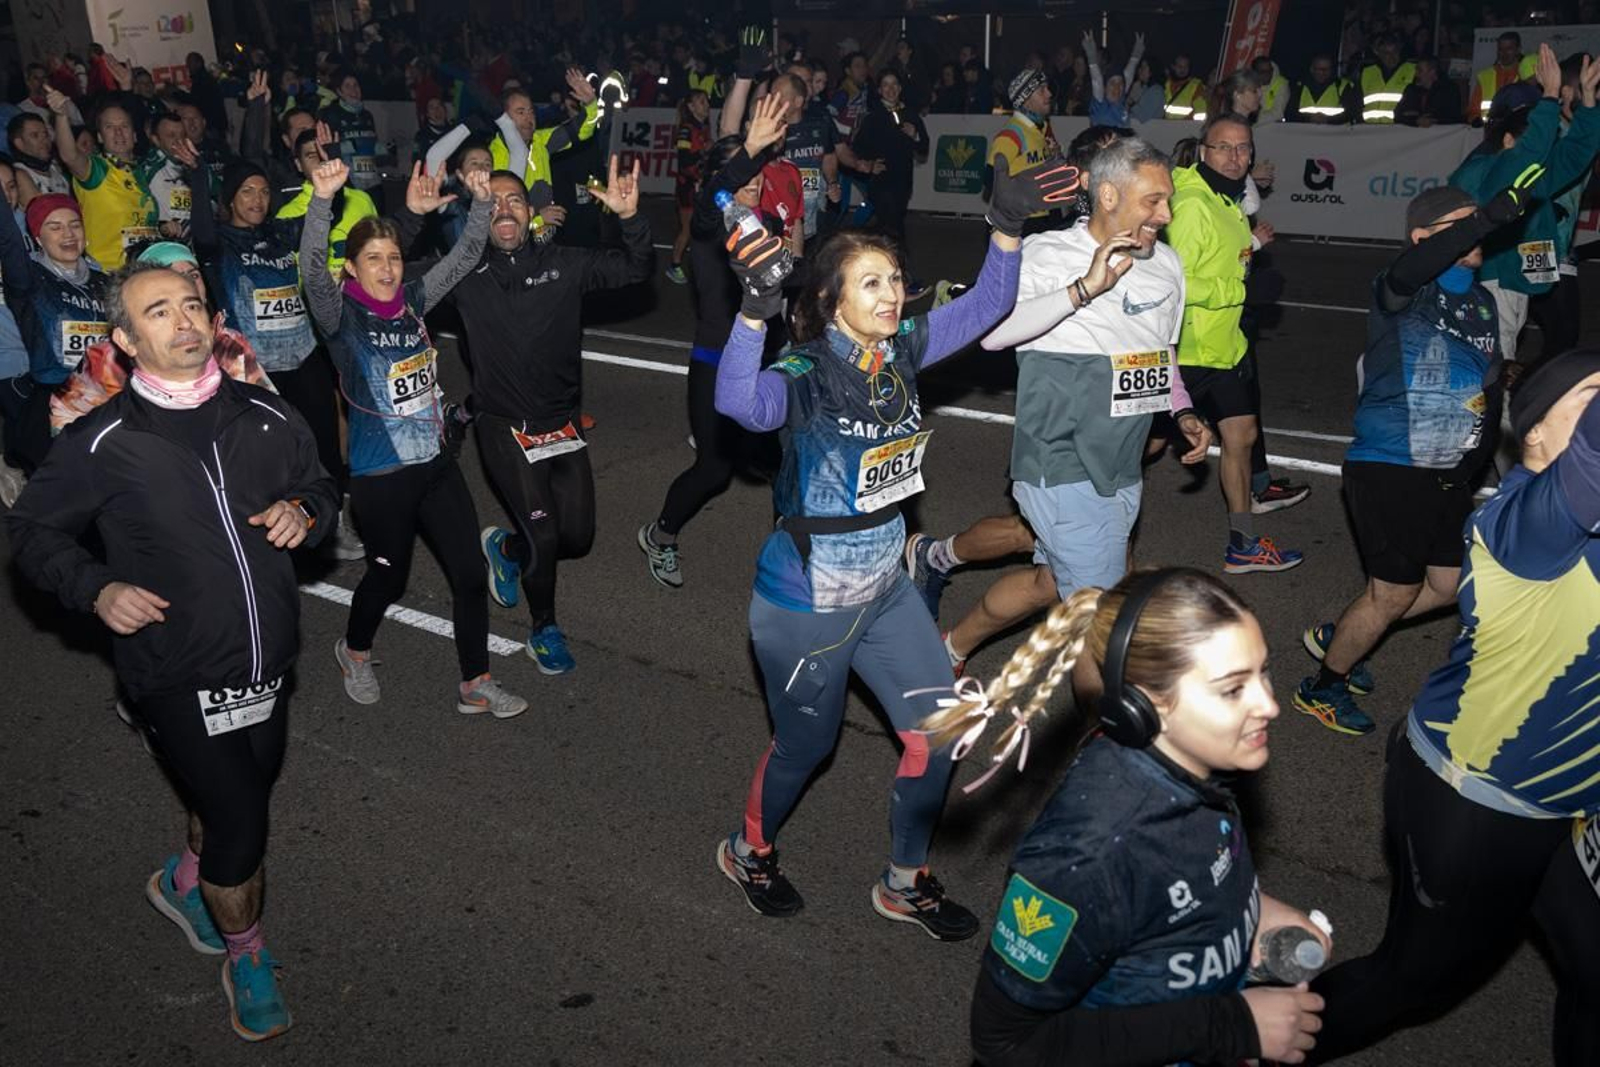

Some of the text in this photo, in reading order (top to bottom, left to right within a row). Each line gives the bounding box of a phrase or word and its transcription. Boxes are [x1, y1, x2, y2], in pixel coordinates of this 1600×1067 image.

[622, 122, 651, 147] 42
[1119, 367, 1169, 392] 6865
[838, 417, 880, 440] SAN
[864, 450, 917, 489] 9061
[1167, 927, 1242, 990] SAN
